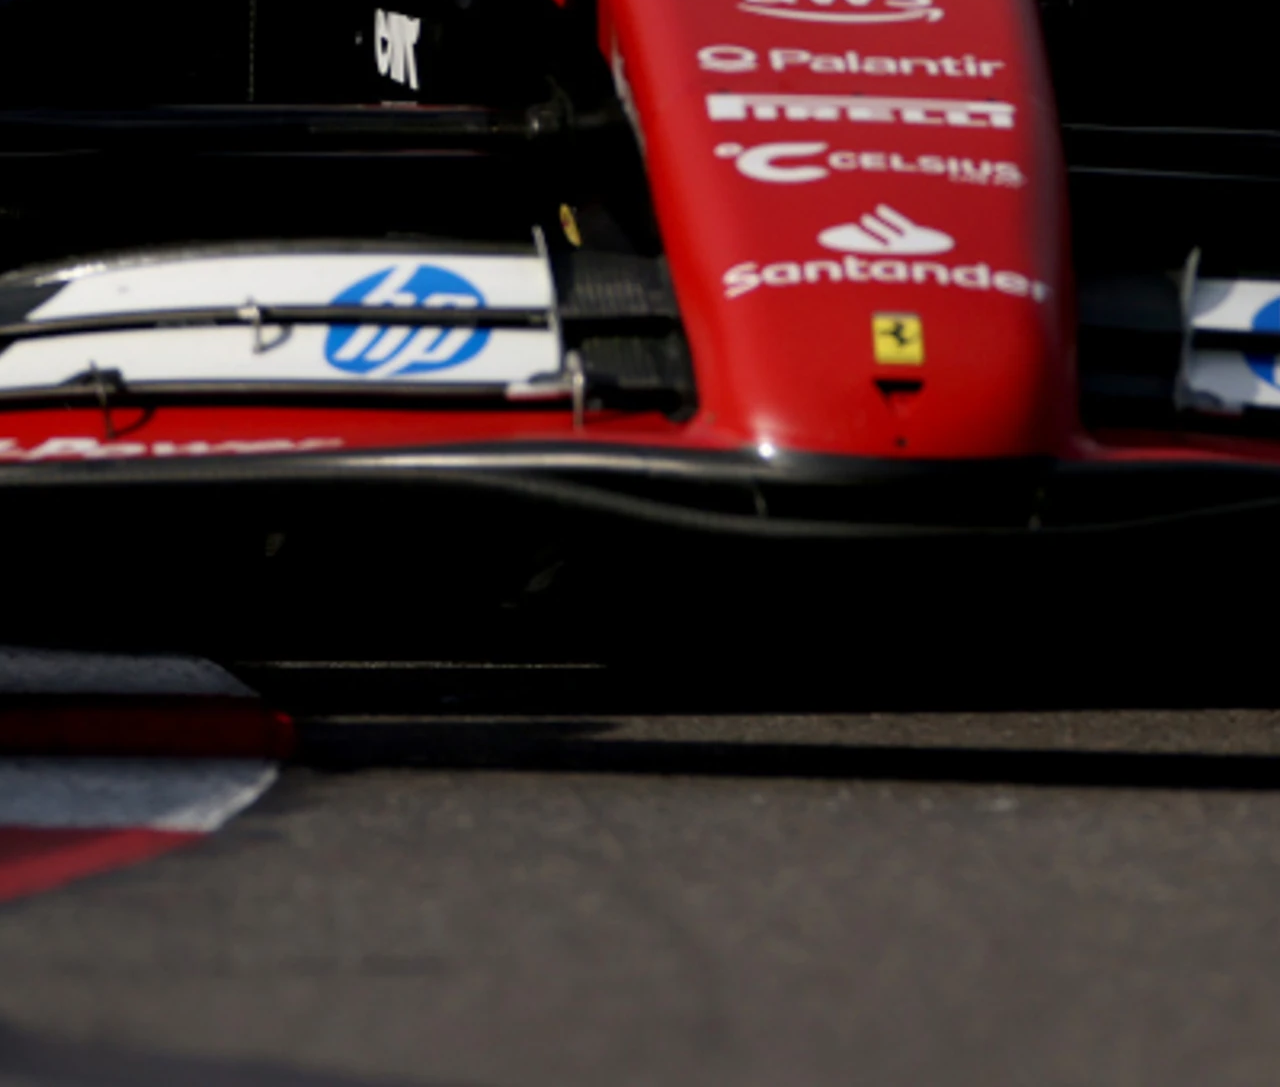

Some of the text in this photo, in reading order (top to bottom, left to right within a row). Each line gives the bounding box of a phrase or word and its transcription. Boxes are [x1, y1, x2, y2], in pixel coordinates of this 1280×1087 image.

[768, 48, 1005, 78] Palantir
[706, 93, 1015, 129] PIRELLI
[829, 152, 1023, 185] CELSIUS
[724, 256, 1055, 303] Santander
[331, 263, 479, 378] hp
